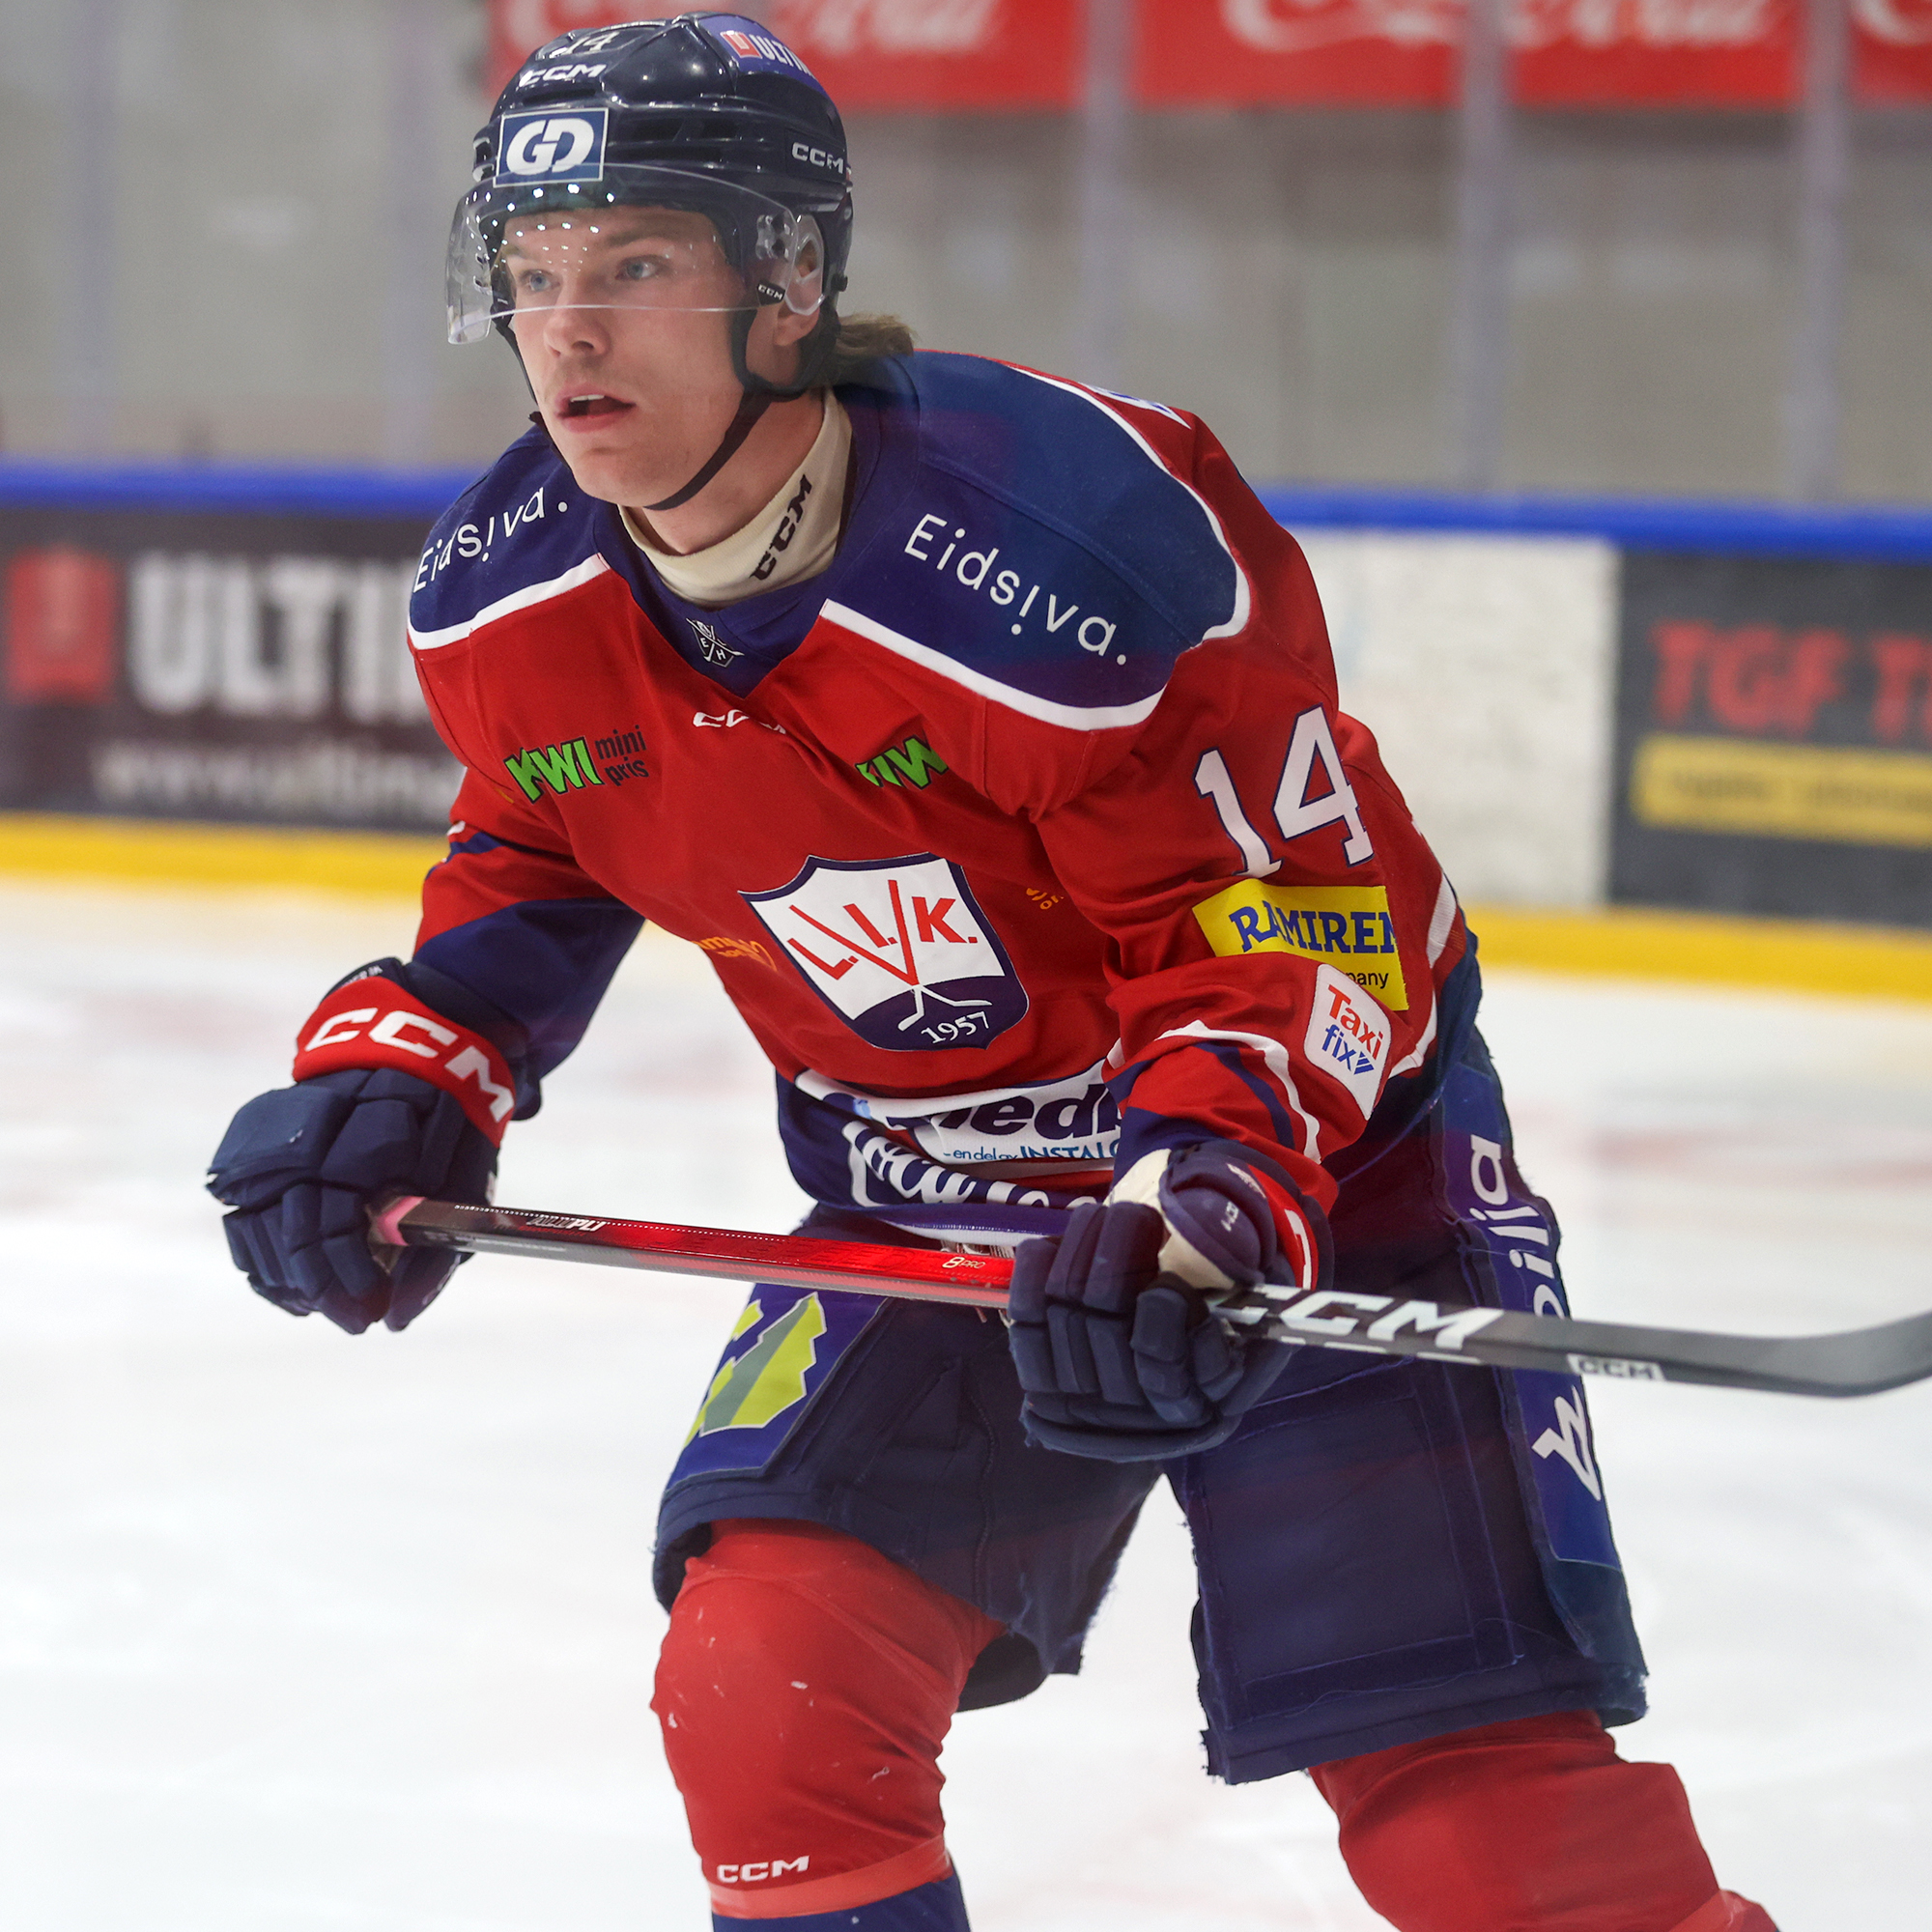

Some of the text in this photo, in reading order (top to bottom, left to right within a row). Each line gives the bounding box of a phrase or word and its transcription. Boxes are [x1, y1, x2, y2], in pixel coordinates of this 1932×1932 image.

[519, 64, 608, 88] CCM
[505, 117, 595, 176] GD
[792, 142, 844, 174] CCM
[758, 284, 783, 300] CCM
[749, 473, 812, 581] CCM
[693, 709, 786, 734] CC
[594, 724, 646, 760] mini
[604, 756, 649, 786] pris
[1194, 703, 1374, 879] 14
[1346, 973, 1389, 989] pany
[922, 1011, 990, 1045] 1957
[1328, 983, 1383, 1060] Taxi
[1321, 1024, 1356, 1071] fix
[305, 1008, 514, 1122] CCM
[1210, 1283, 1503, 1351] CCM
[1578, 1358, 1654, 1379] CCM
[717, 1855, 810, 1883] CCM
